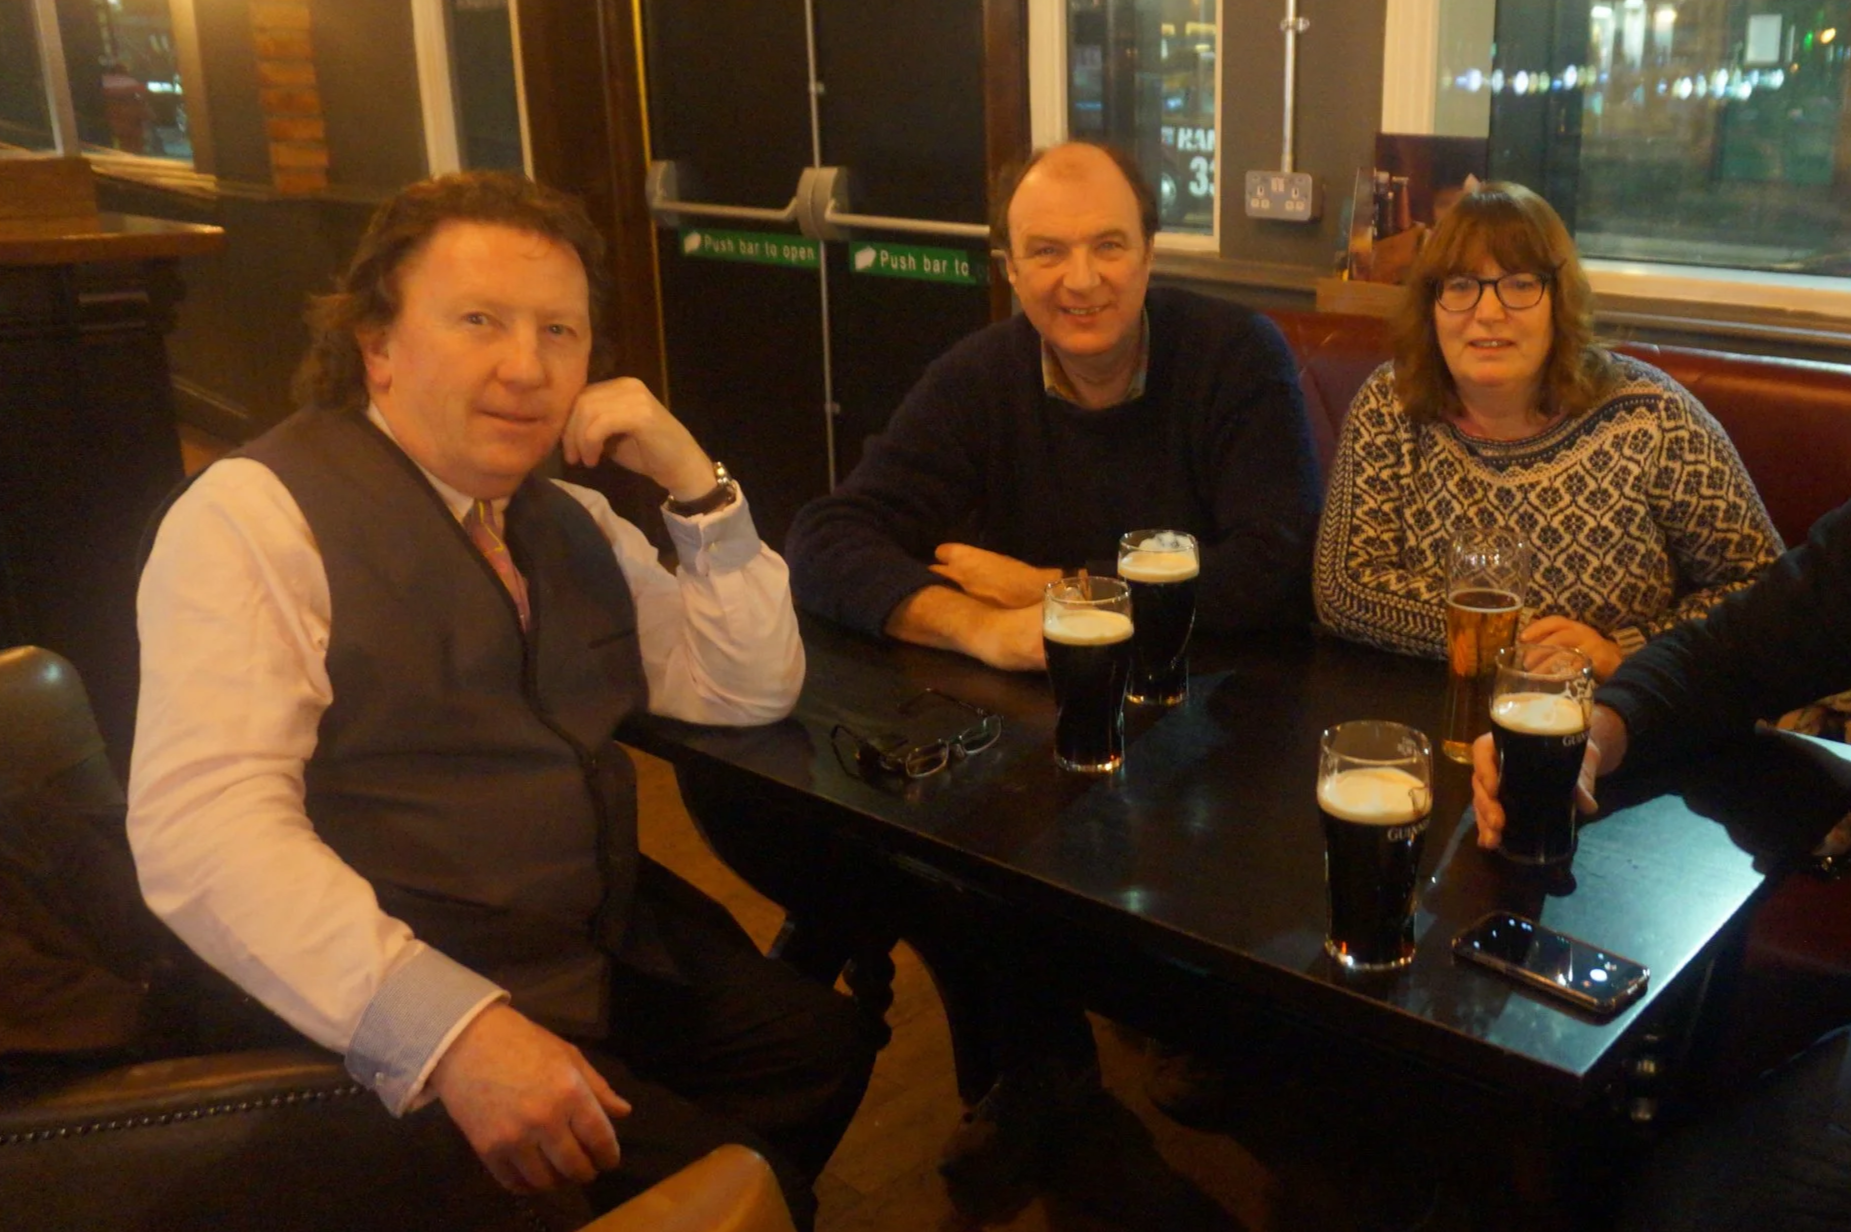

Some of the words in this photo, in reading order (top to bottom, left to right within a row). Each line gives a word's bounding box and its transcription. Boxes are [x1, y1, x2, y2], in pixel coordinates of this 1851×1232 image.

[704, 233, 734, 254] Push
[739, 239, 760, 256] bar
[764, 242, 778, 259] to
[782, 244, 816, 262] open
[880, 249, 916, 271] Push
[923, 254, 948, 275] bar
